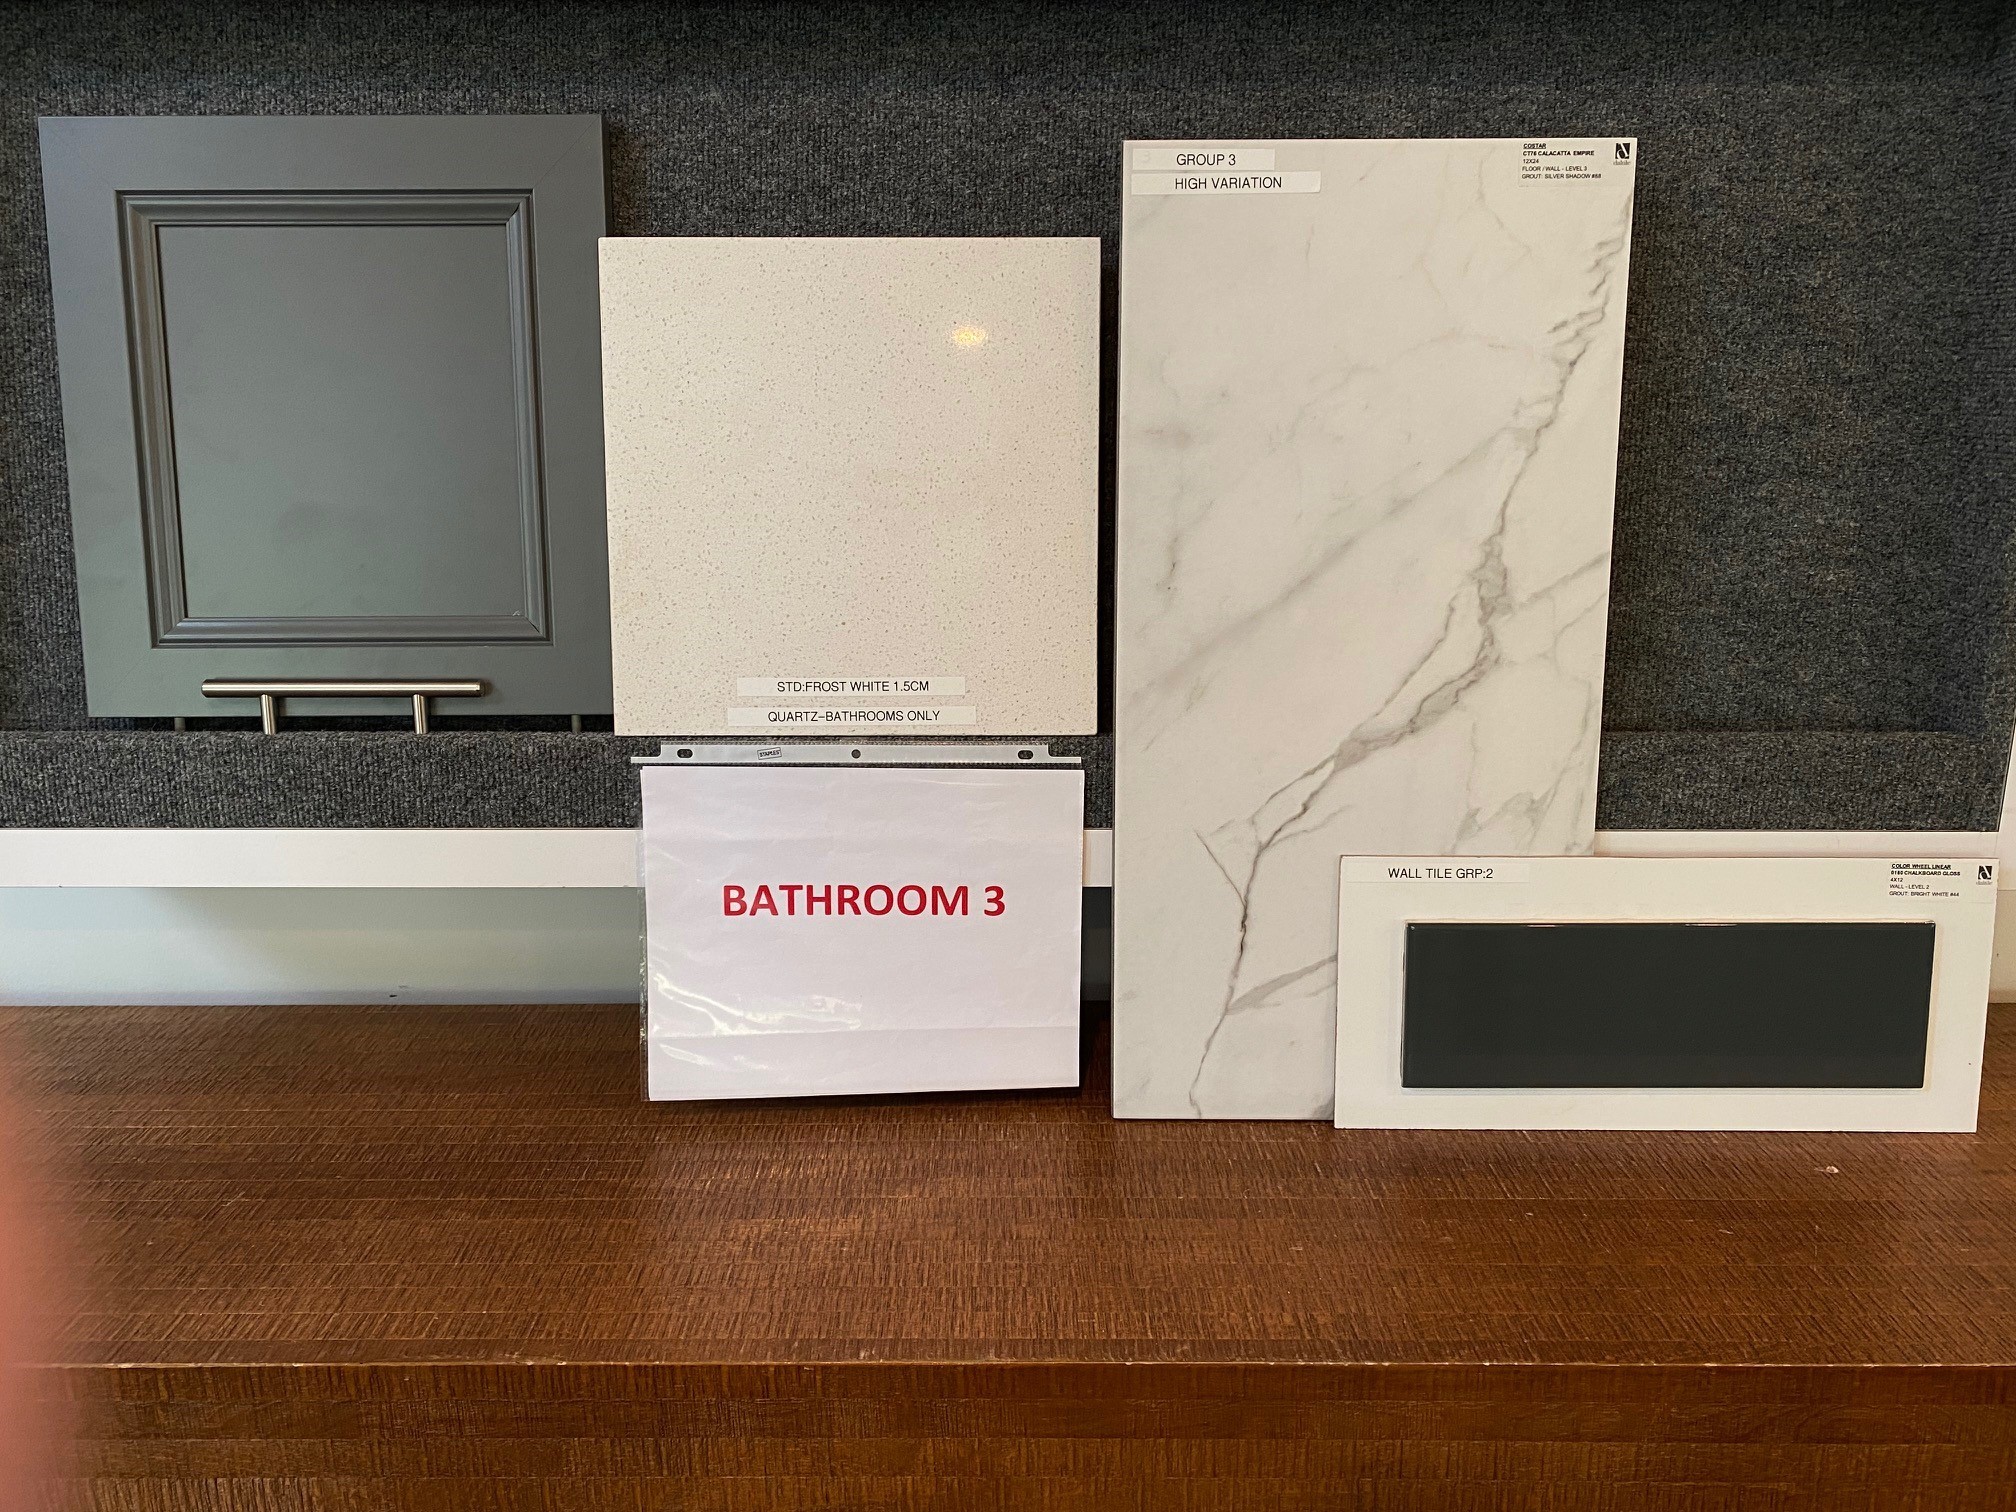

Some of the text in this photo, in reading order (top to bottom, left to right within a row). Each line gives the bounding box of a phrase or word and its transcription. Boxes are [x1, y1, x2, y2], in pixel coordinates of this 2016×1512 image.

[1176, 153, 1236, 166] GROUP 3
[1174, 176, 1282, 190] HIGH VARIATION
[777, 680, 929, 693] STD:FROST WHITE 1.5CM
[767, 710, 940, 723] QUARTZ-BATHROOMS ONLY
[1388, 867, 1494, 879] WALL TILE GRP:2
[723, 884, 1006, 917] BATHROOM 3
